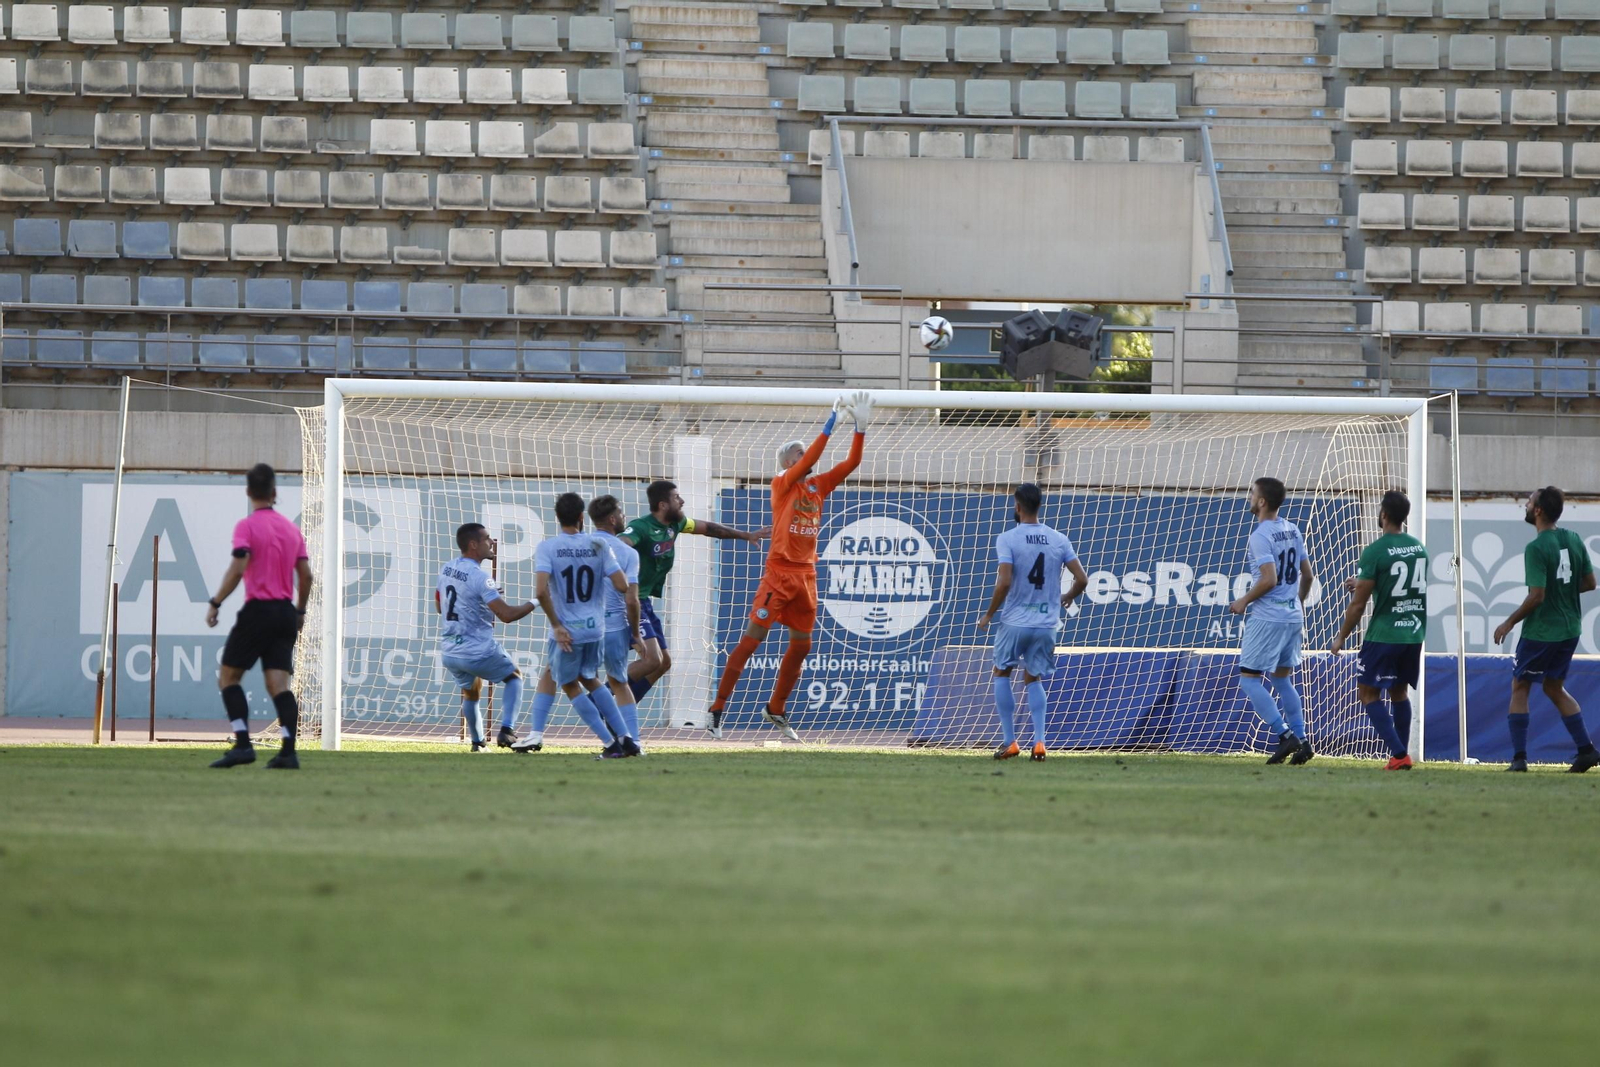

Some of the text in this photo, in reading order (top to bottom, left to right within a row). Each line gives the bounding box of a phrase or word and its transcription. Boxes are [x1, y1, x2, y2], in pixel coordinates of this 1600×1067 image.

[789, 524, 799, 534] EL
[1025, 534, 1050, 545] MIKEL
[556, 548, 575, 558] JORGE
[840, 536, 920, 556] RADIO
[1387, 544, 1423, 556] blauverd
[829, 564, 933, 596] MARCA
[1028, 551, 1045, 590] 4
[1276, 547, 1298, 586] 18
[1390, 557, 1427, 597] 24
[1556, 548, 1573, 585] 4
[561, 564, 595, 604] 10
[764, 592, 773, 606] 1
[445, 584, 459, 622] 2
[394, 696, 441, 718] 391
[807, 681, 876, 711] 92.1
